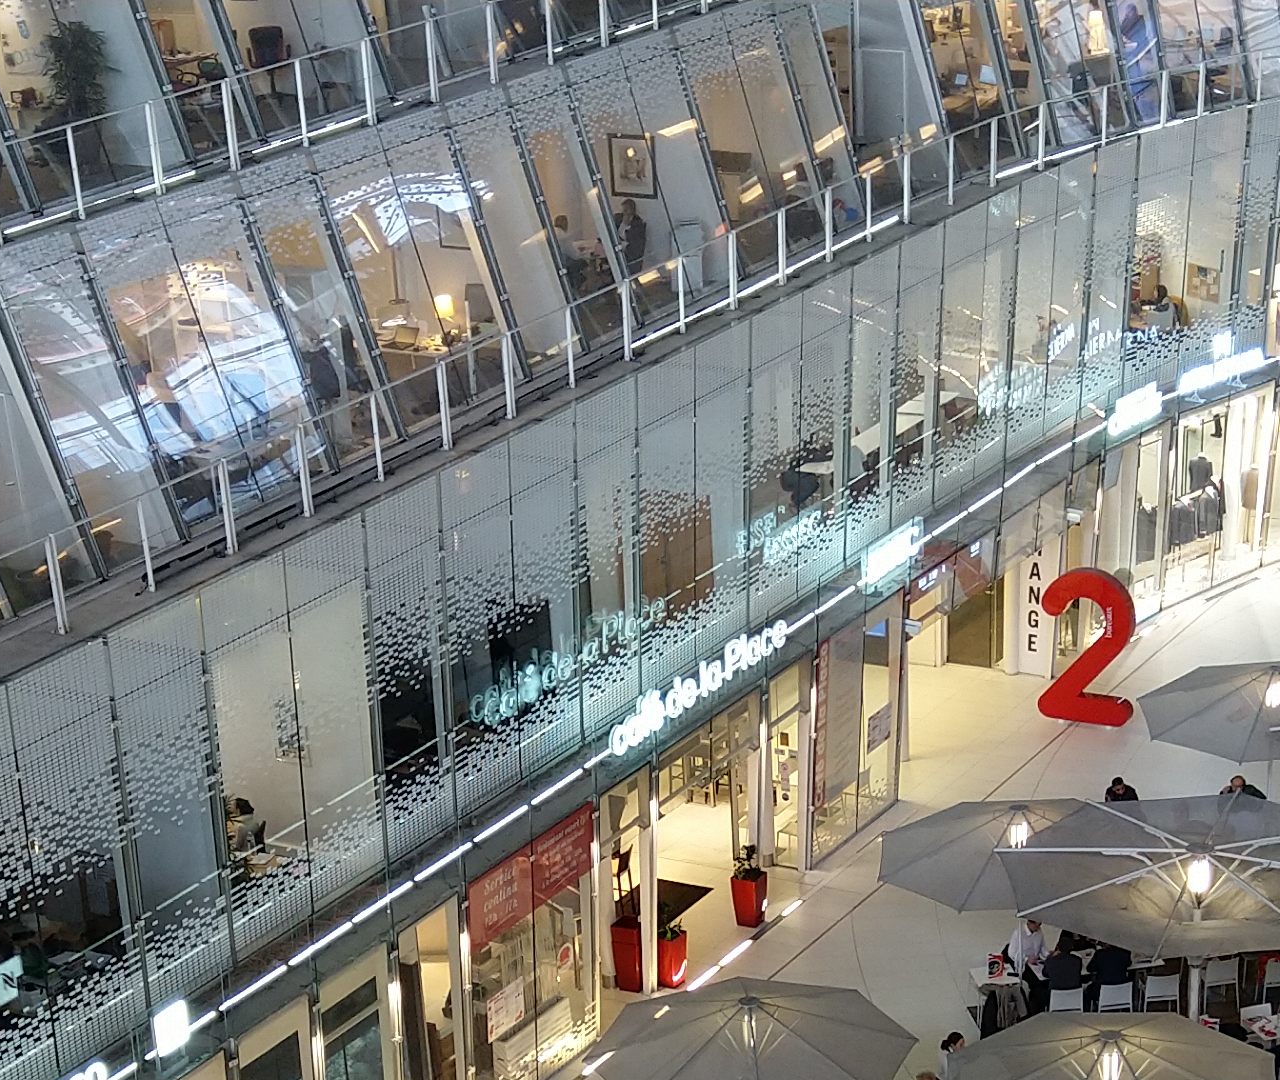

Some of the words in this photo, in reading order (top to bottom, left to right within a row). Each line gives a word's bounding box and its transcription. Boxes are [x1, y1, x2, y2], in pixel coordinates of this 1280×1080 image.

[665, 675, 698, 719] de
[699, 659, 723, 698] la
[723, 619, 788, 681] Place
[1038, 567, 1136, 728] 2
